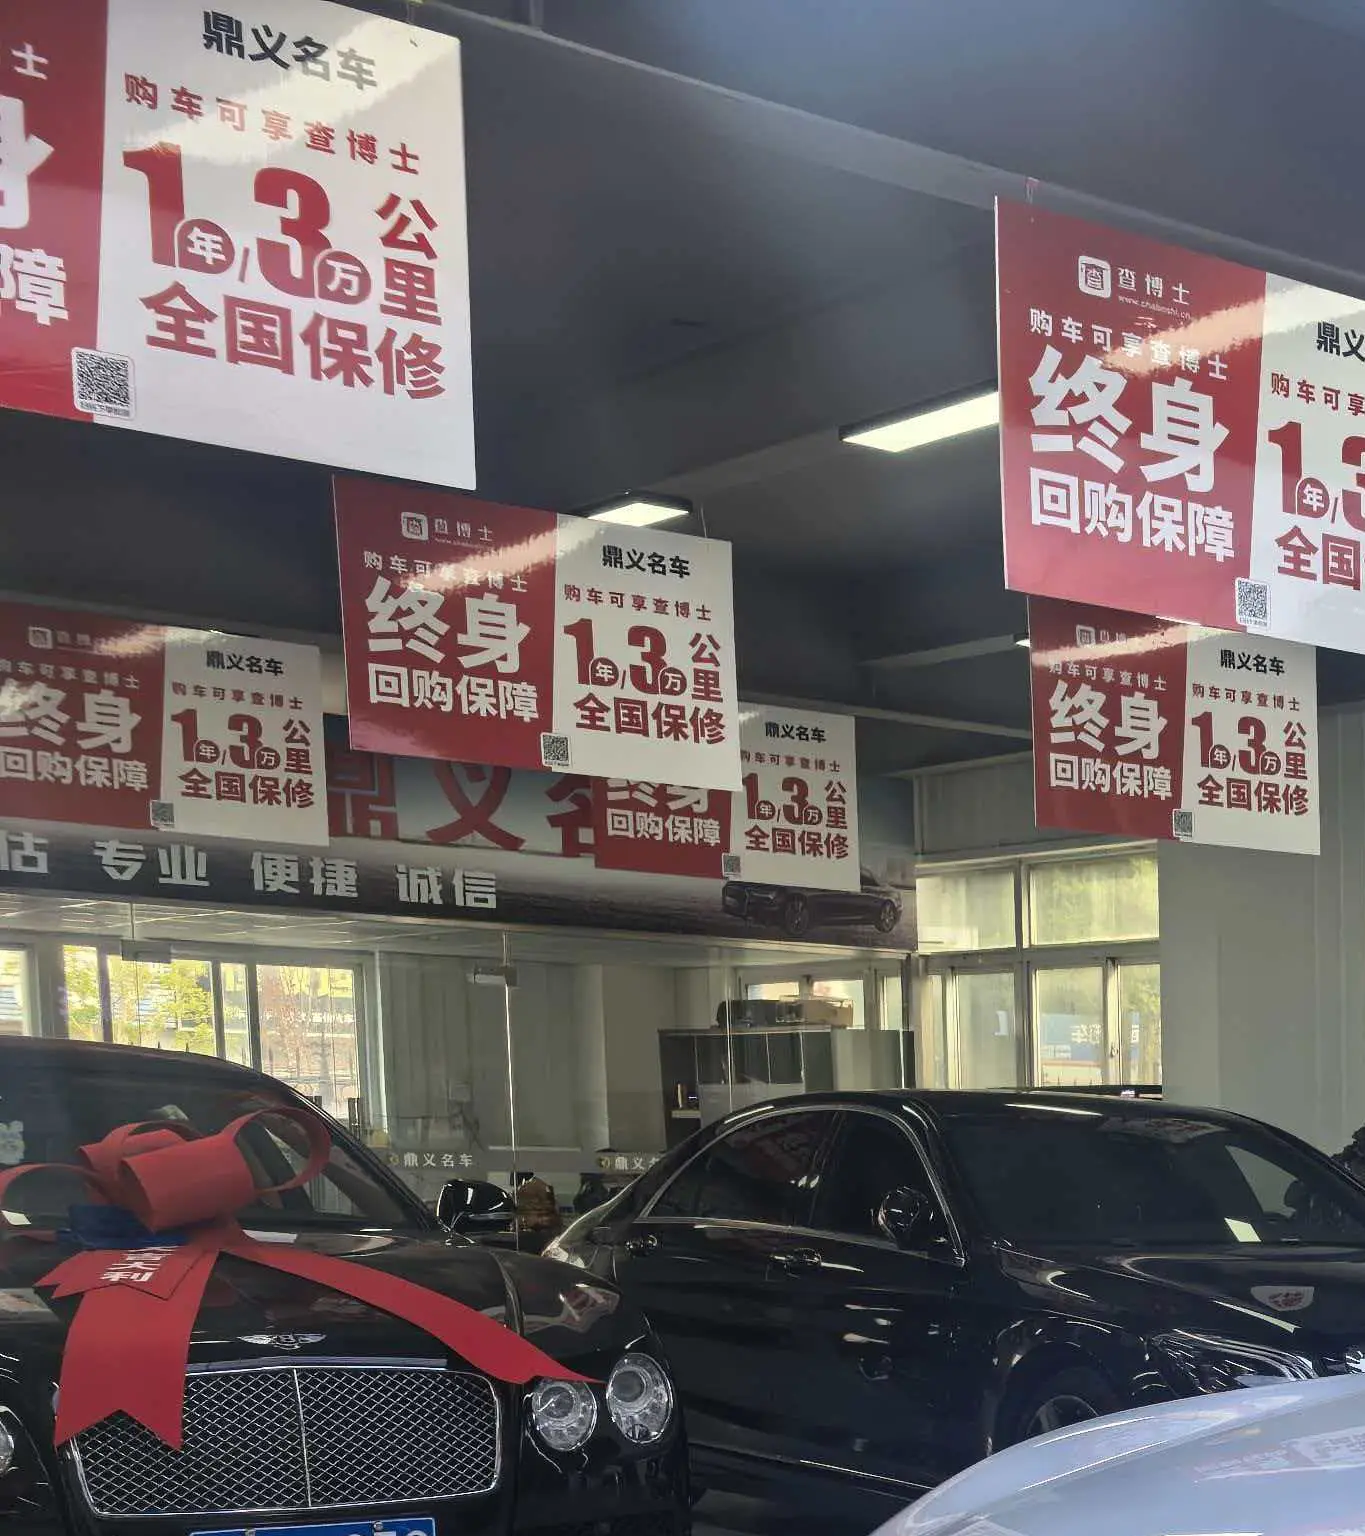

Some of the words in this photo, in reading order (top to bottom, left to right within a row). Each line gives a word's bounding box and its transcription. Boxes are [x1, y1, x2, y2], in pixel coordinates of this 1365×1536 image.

[202, 9, 378, 91] 鼎义名车
[123, 72, 420, 176] 购车可享查博士
[139, 281, 446, 400] 全国保修
[1029, 308, 1228, 381] 购车可享查博士
[1028, 344, 1229, 493] 终身
[1029, 467, 1235, 563] 回购保障
[602, 544, 691, 579] 鼎义名车
[365, 576, 531, 674] 终身
[564, 583, 712, 622] 购车可享查博士
[206, 650, 284, 677] 鼎义名车
[1220, 649, 1285, 677] 鼎义名车
[367, 662, 539, 724] 回购保障
[574, 693, 726, 745] 全国保修
[1049, 679, 1168, 760] 终身
[0, 746, 148, 792] 回购保障
[178, 768, 314, 809] 全国保修
[1049, 752, 1172, 801] 回购保障
[1197, 774, 1309, 817] 全国保修
[607, 807, 721, 847] 回购保障
[745, 824, 849, 860] 全国保修
[94, 838, 210, 887] 专业
[250, 849, 359, 898] 便捷
[396, 863, 498, 910] 诚信
